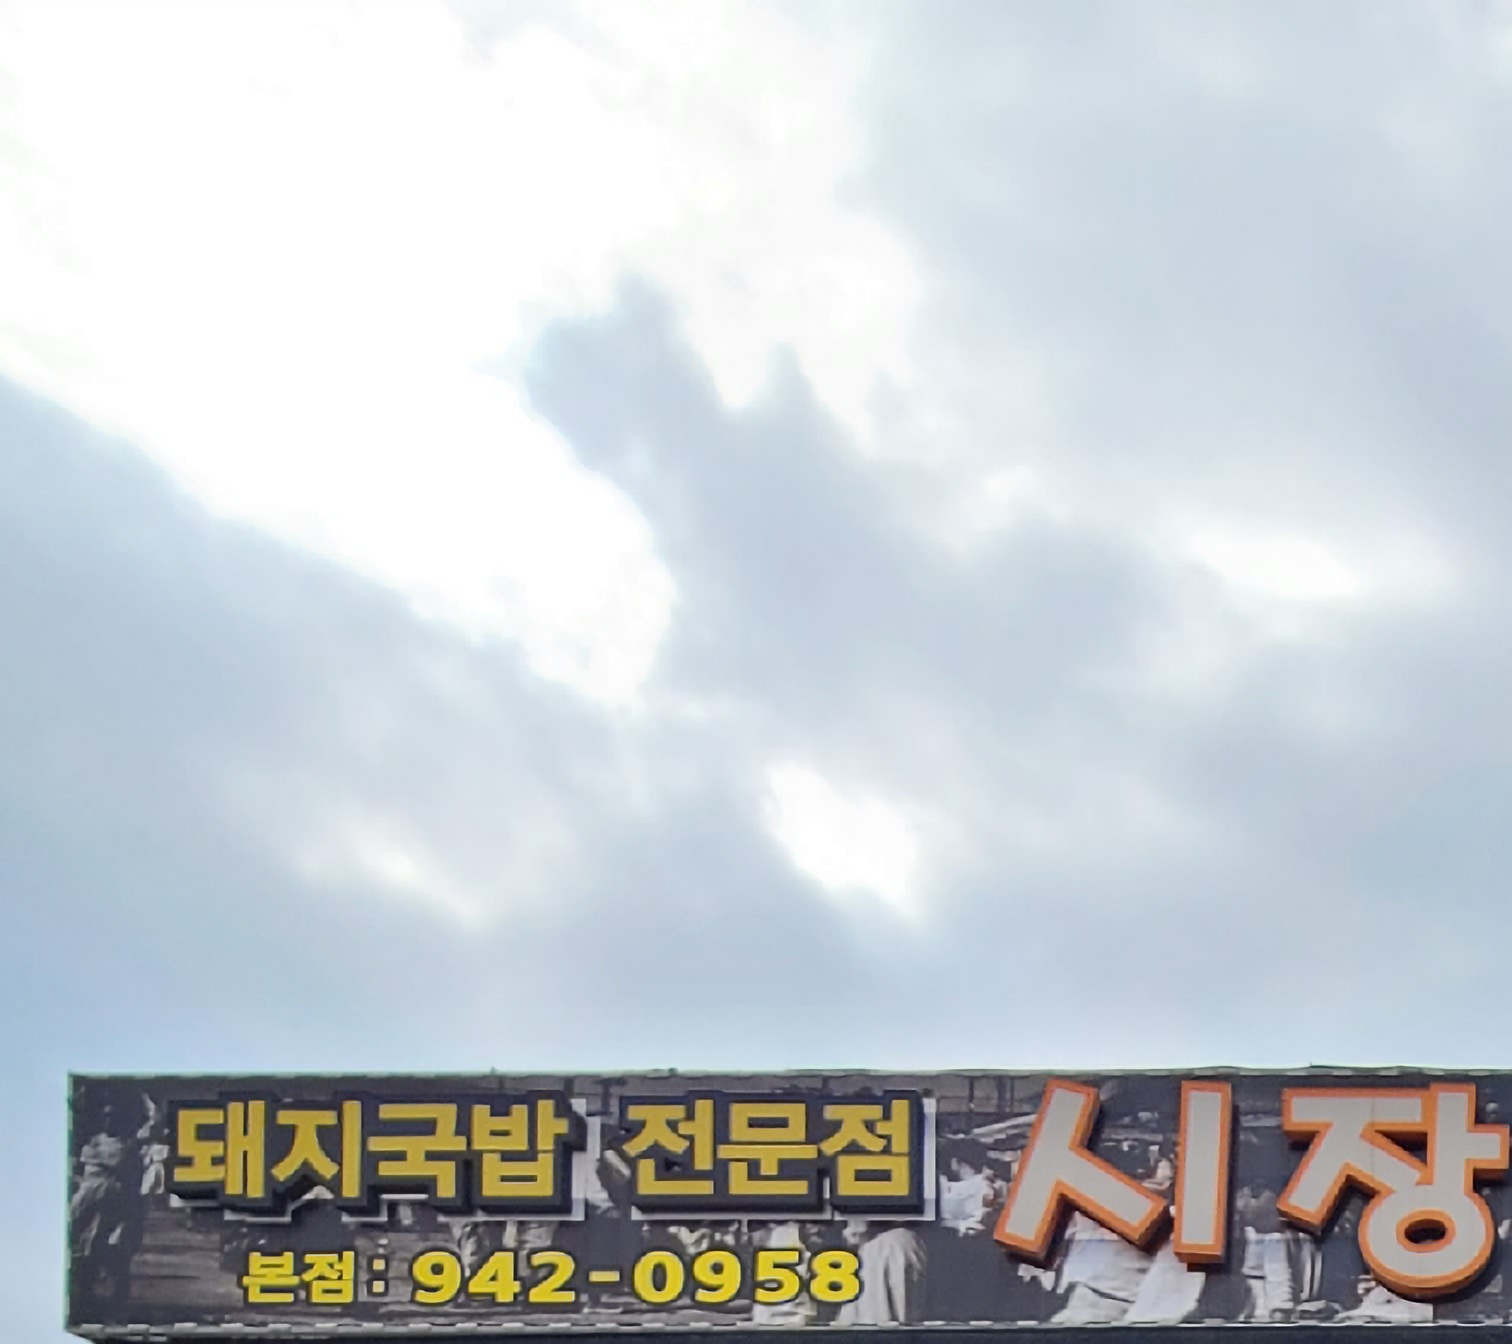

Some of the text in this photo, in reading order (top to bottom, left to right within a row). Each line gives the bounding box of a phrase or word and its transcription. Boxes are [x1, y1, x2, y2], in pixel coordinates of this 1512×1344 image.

[172, 1099, 912, 1198] 돼지국밥 전문점
[410, 1247, 862, 1305] 942-0958
